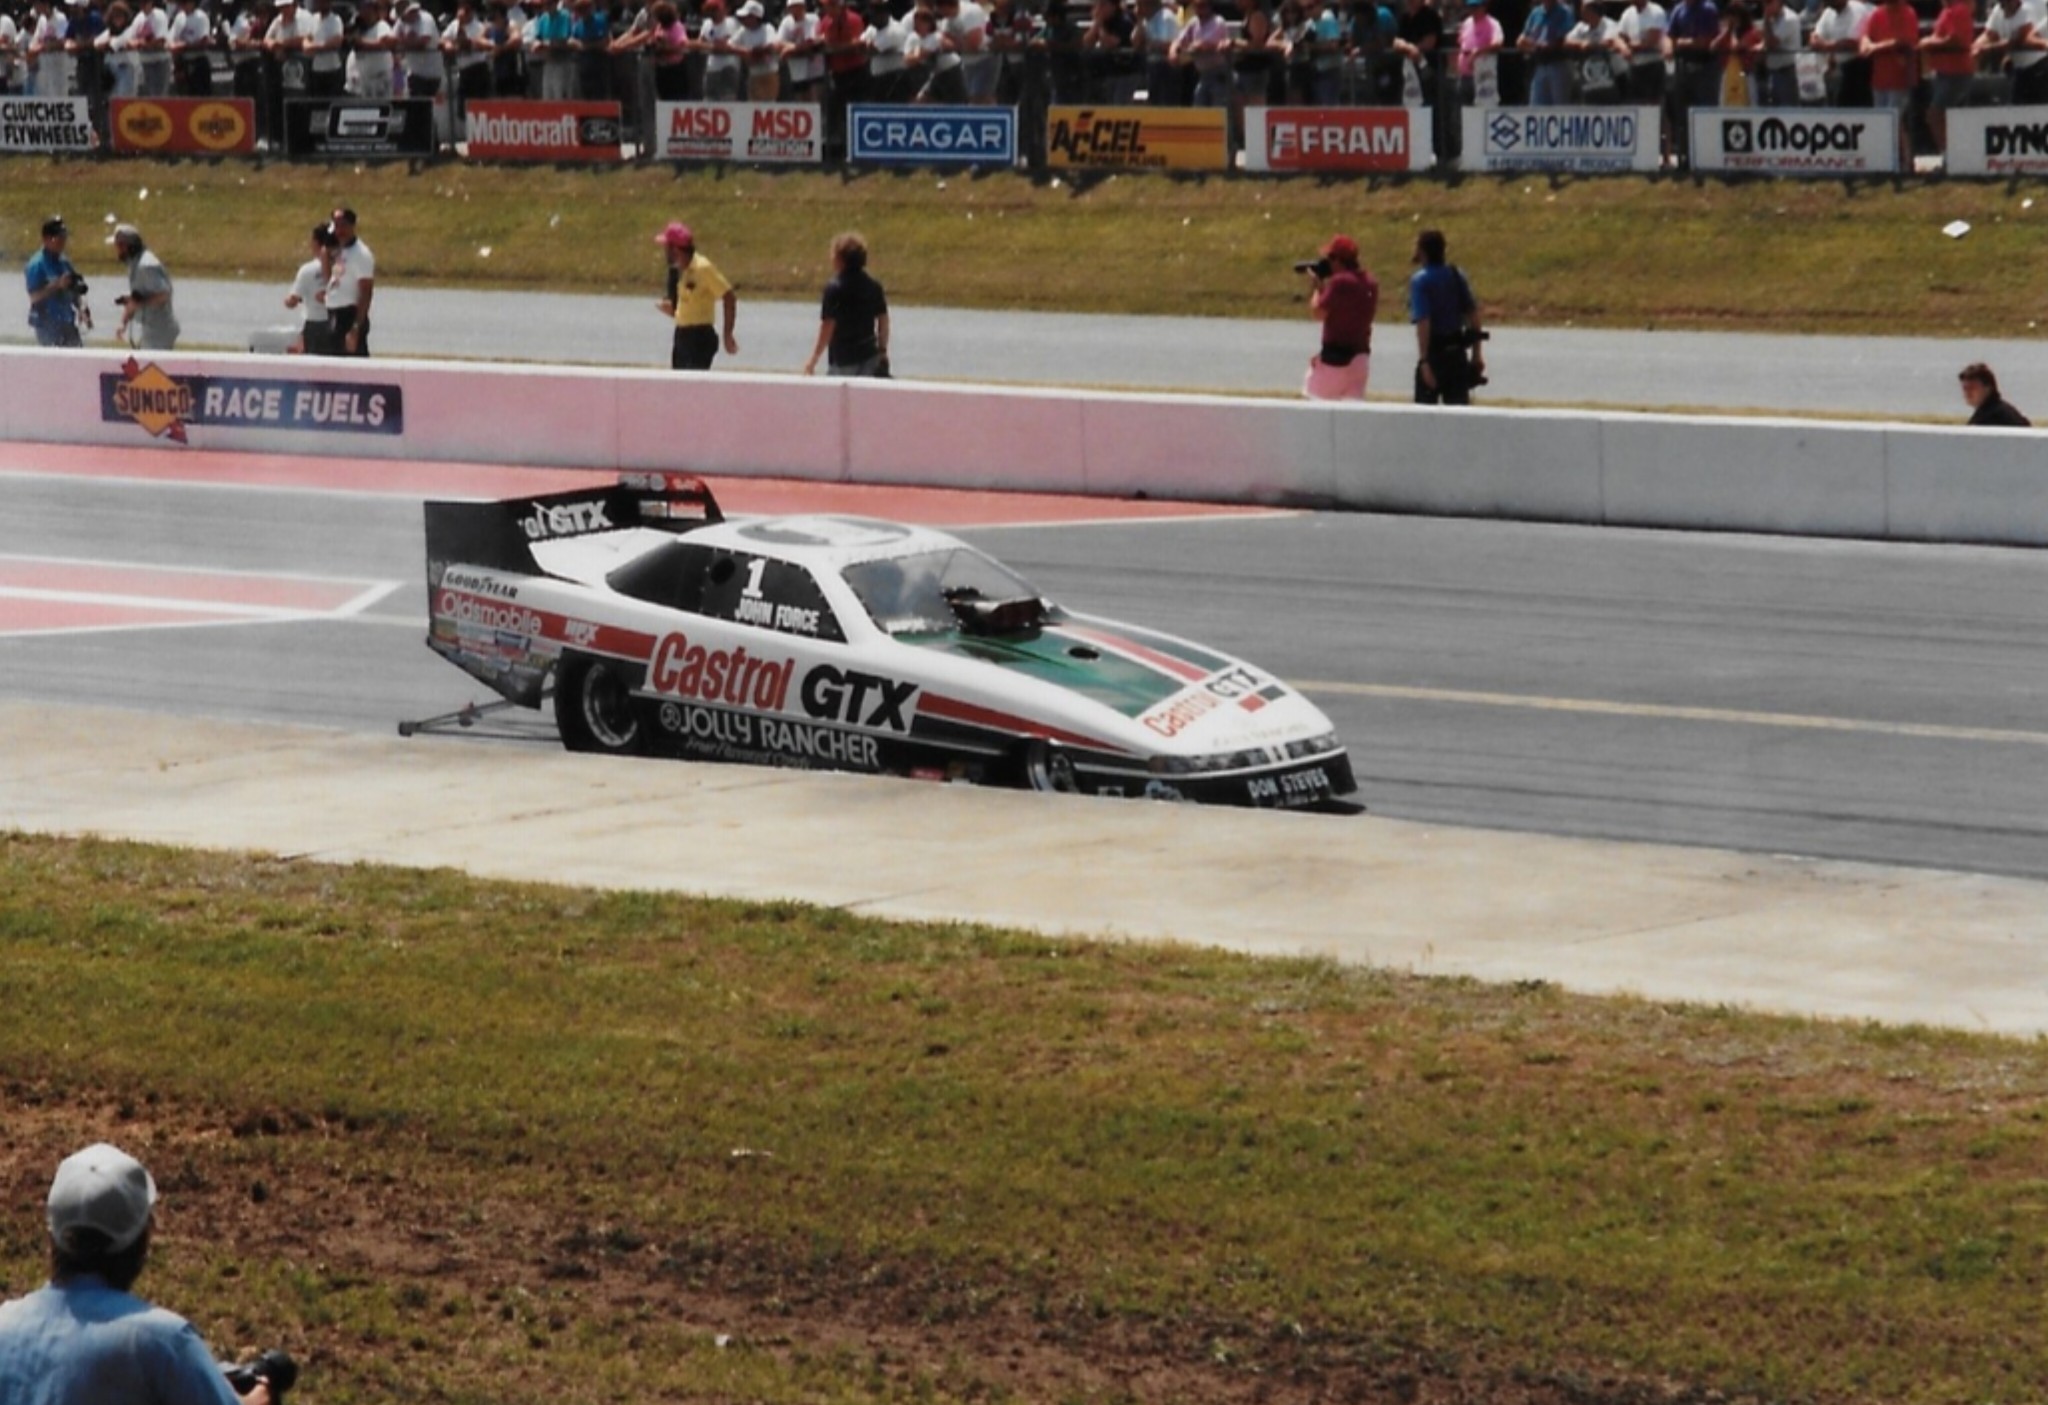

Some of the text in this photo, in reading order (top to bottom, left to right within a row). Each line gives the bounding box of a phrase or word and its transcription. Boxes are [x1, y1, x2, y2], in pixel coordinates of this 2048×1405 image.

[2, 102, 75, 122] CLUTCHES
[465, 111, 579, 147] Motorcraft
[671, 107, 732, 137] MSD
[751, 108, 814, 139] MSD
[3, 122, 90, 146] FLYWHEELS
[862, 121, 1002, 148] CRAGAR
[1301, 125, 1405, 154] FRAM
[1525, 115, 1635, 148] RICHMOND
[1757, 116, 1866, 156] Mopar
[112, 381, 192, 419] SUNOCO
[203, 386, 387, 426] RACE FUELS
[549, 499, 614, 535] GTX
[742, 557, 770, 598] 1
[441, 592, 543, 635] Oldsmobile
[734, 597, 821, 632] JOHN FORCE
[651, 631, 919, 733] Castrol GTX
[680, 705, 751, 744] JOLLY
[760, 720, 880, 767] RANCHER
[1246, 776, 1280, 799] DON
